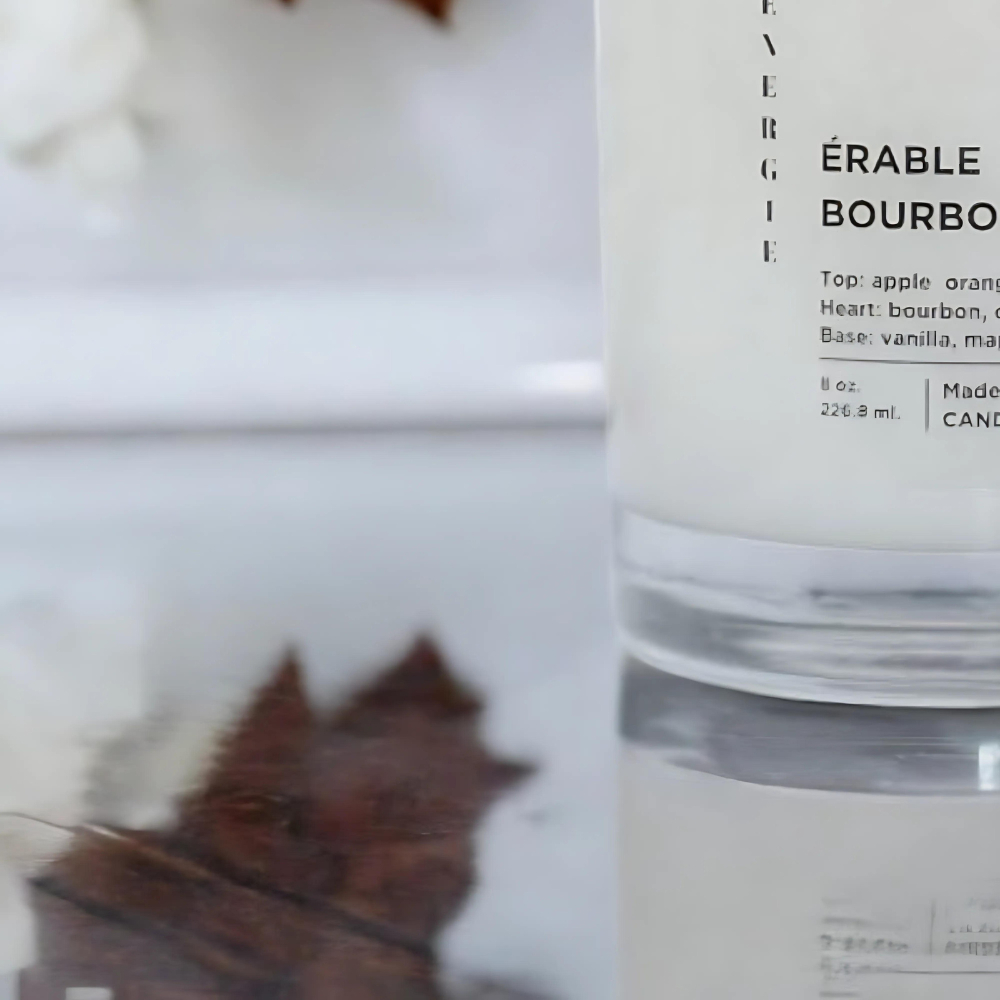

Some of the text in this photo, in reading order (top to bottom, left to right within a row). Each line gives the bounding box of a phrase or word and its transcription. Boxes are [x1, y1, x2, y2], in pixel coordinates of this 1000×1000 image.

[821, 135, 982, 176] ÉRABLE
[820, 270, 865, 292] Top:
[819, 299, 882, 318] Heart:
[888, 301, 988, 324] bourbon,
[819, 325, 873, 346] Base:
